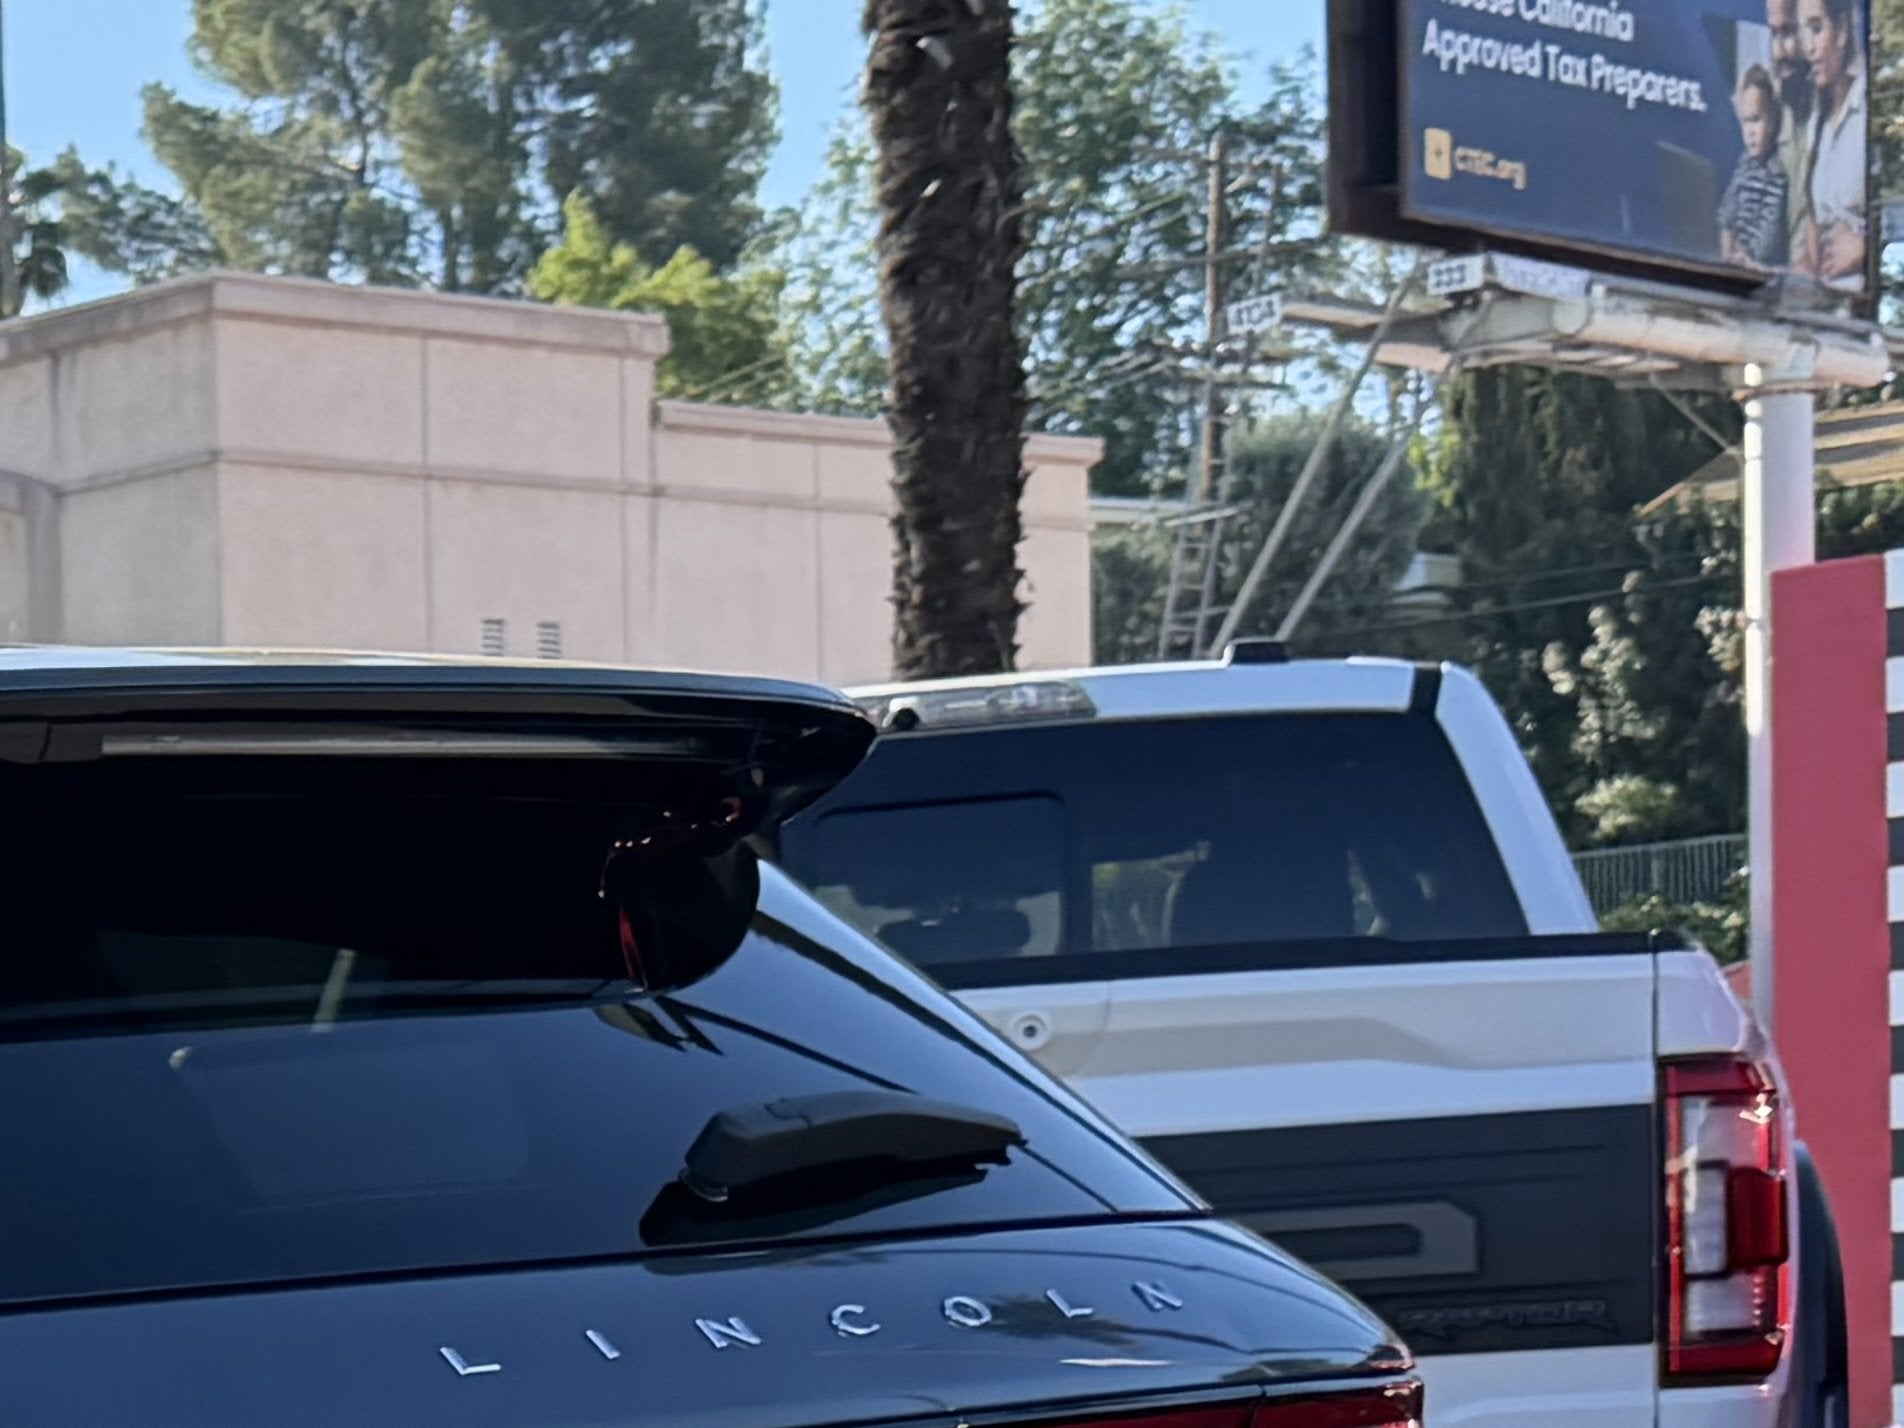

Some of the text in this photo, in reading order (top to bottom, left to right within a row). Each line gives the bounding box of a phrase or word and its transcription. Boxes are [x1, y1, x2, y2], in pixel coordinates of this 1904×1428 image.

[1422, 18, 1709, 112] Approved Tax Preparers.
[1518, 0, 1635, 42] California
[439, 1279, 1184, 1376] LINCOLN
